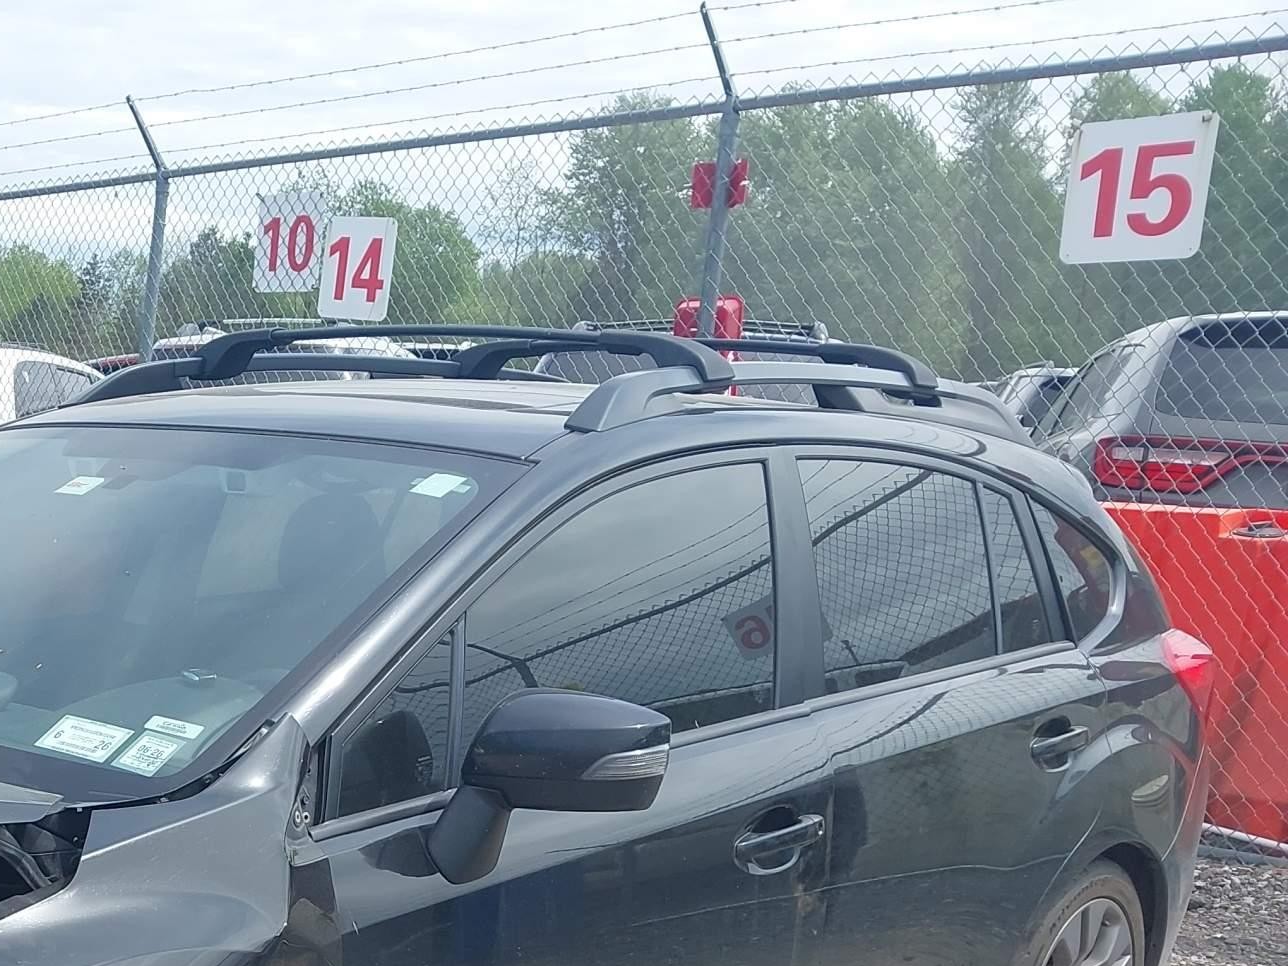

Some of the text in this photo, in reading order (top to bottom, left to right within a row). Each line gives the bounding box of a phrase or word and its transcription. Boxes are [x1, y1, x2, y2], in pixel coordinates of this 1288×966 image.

[1081, 140, 1195, 238] 15
[263, 214, 314, 272] 10
[329, 237, 384, 302] 14
[93, 740, 112, 751] 26
